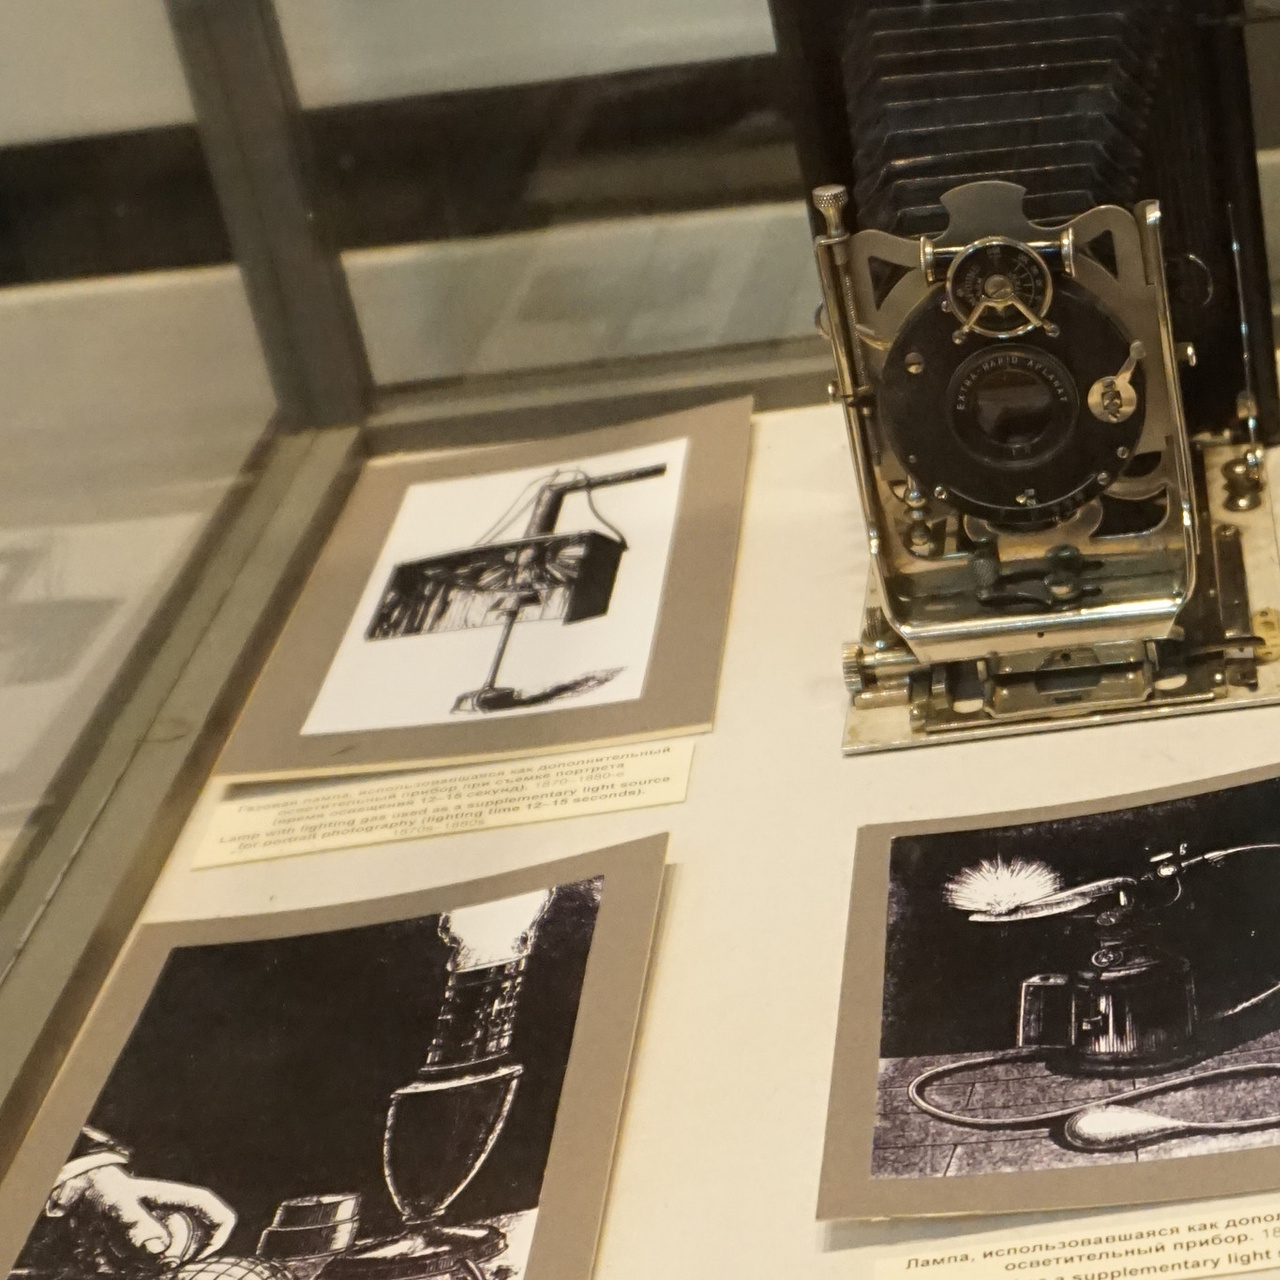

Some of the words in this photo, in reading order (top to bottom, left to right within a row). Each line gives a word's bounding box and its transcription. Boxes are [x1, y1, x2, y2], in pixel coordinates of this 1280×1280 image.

[956, 355, 1018, 410] EXTRA-RAPID
[1027, 359, 1068, 402] APLANAT
[401, 785, 458, 798] прибор
[463, 781, 490, 790] при
[556, 762, 625, 776] портрета
[511, 767, 533, 775] как
[537, 746, 671, 772] дополнительный
[219, 832, 261, 844] Lamp
[265, 827, 295, 837] with
[300, 819, 356, 832] lighting
[360, 815, 386, 825] gas
[391, 808, 427, 818] used
[466, 789, 578, 809] supplementary
[582, 782, 615, 793] light
[619, 776, 671, 788] source
[238, 841, 261, 850] for
[262, 831, 318, 848] portrait
[320, 819, 416, 839] photography
[420, 809, 483, 825] (lighting
[488, 804, 520, 815] time
[906, 1252, 976, 1270] Лампа,
[982, 1227, 1181, 1260] использовавшаяся
[1187, 1220, 1219, 1233] как
[1004, 1241, 1166, 1271] осветительный
[1173, 1230, 1255, 1252] прибор.
[1227, 1245, 1272, 1266] light
